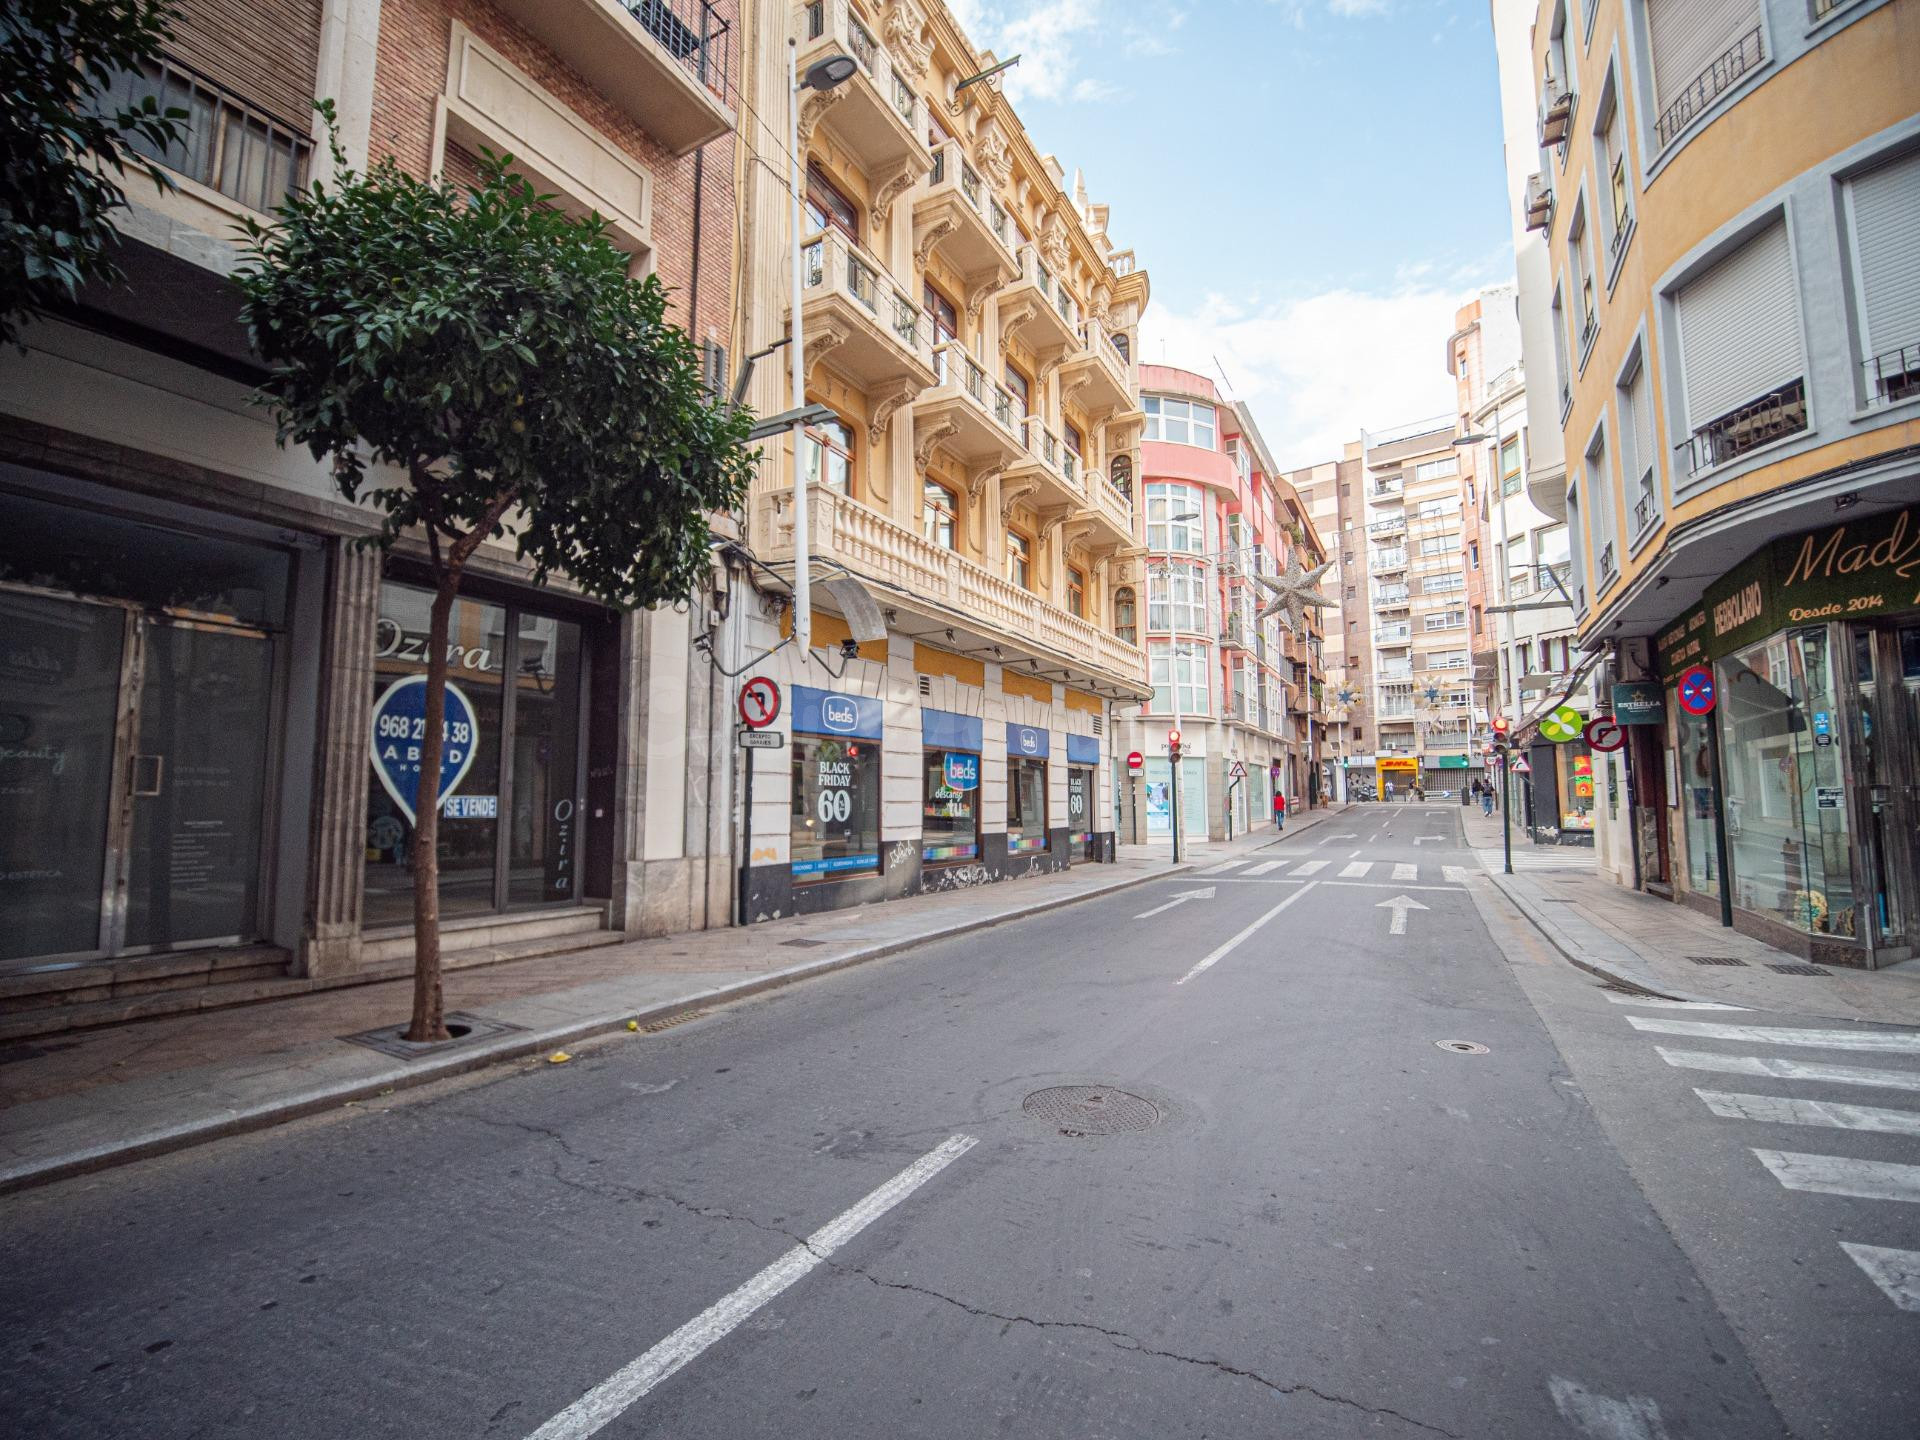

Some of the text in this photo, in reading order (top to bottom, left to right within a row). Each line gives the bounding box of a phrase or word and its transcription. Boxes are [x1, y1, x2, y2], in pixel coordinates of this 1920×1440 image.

[1783, 510, 1920, 587] Mad
[1713, 581, 1762, 637] HERBOLARIO
[1788, 594, 1884, 621] Desde 2014
[380, 714, 409, 738] 968
[451, 721, 469, 743] 38
[818, 775, 851, 787] FRIDAY
[819, 762, 850, 775] BLACK
[446, 799, 496, 817] SE VENDE
[817, 789, 851, 823] 60
[1070, 794, 1083, 814] 60
